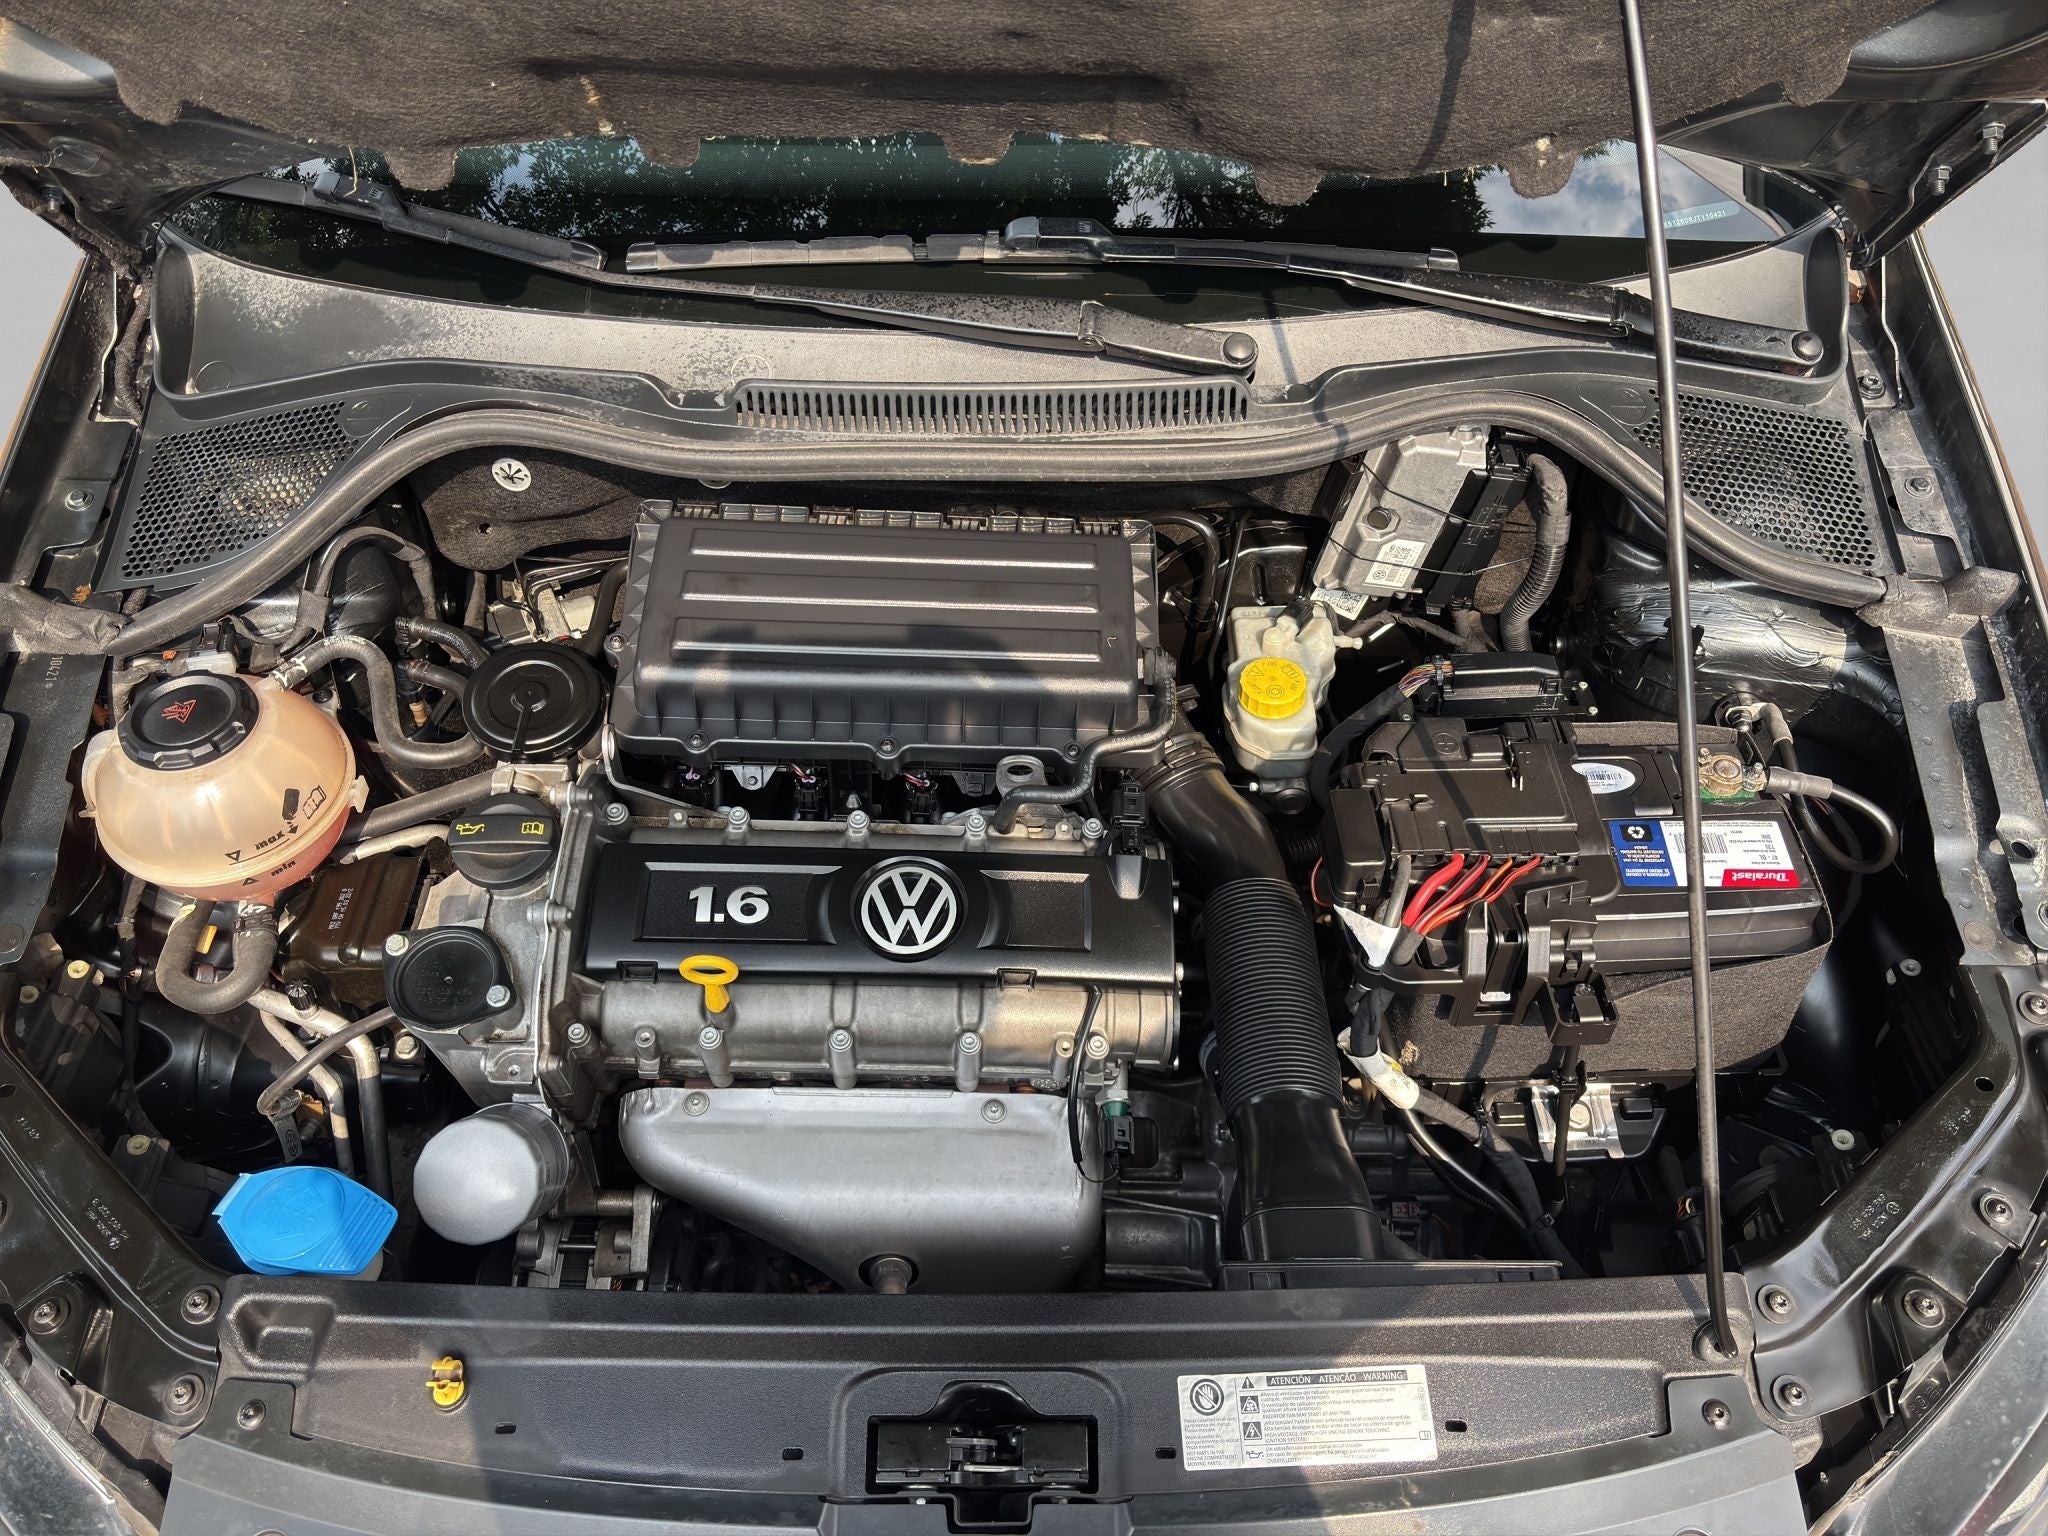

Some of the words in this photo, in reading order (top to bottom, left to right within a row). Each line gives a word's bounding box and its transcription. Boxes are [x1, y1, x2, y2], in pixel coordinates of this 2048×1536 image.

[254, 830, 286, 850] max
[270, 860, 296, 877] min
[1730, 871, 1789, 881] Duralast
[688, 886, 770, 924] 1.6
[860, 866, 958, 954] VW
[1270, 1374, 1310, 1385] ATENCIÓN
[1319, 1372, 1356, 1384] ATENÇÃO
[1363, 1371, 1403, 1380] WARNING
